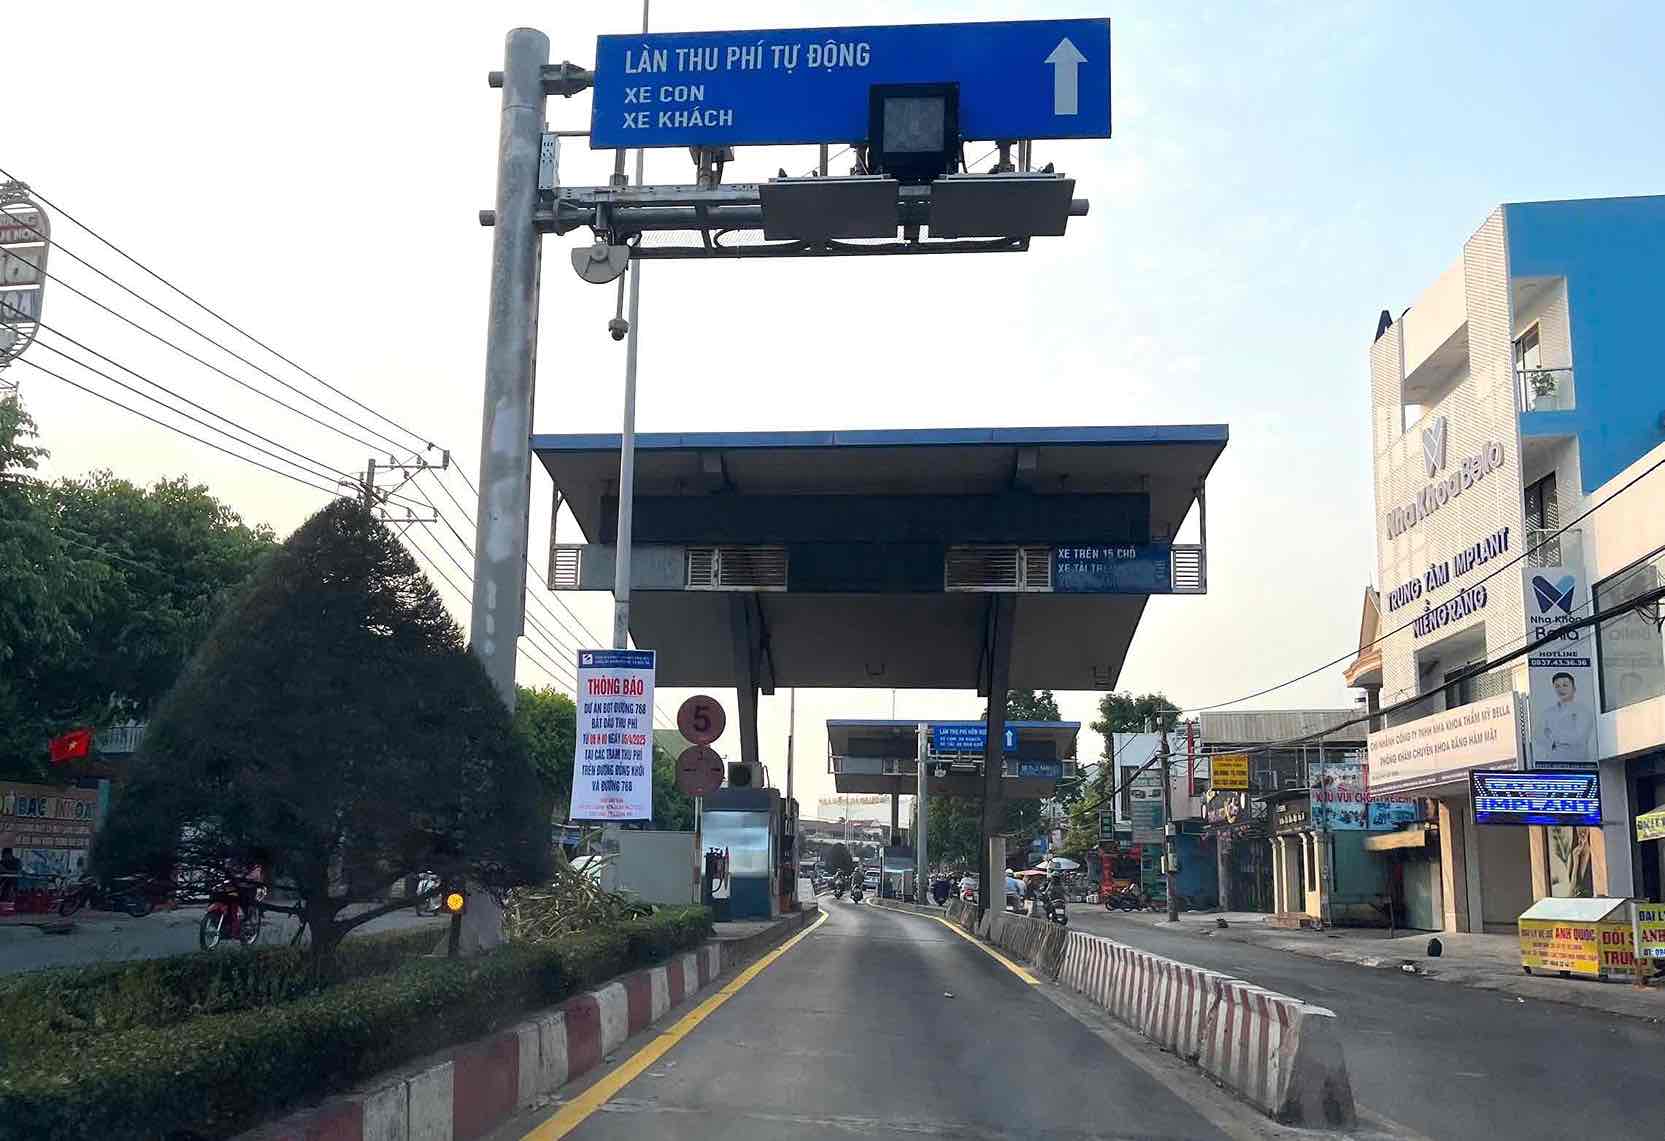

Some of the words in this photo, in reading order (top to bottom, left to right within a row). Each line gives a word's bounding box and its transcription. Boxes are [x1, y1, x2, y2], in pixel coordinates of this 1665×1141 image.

[625, 44, 668, 74] LÀN
[676, 48, 718, 72] THU
[726, 40, 763, 70] PHÍ
[772, 44, 800, 73] TỰ
[807, 40, 871, 72] ĐỘNG
[624, 86, 652, 104] XE
[660, 84, 705, 103] CON
[623, 111, 650, 129] XE
[658, 106, 733, 128] KHÁCH
[1058, 549, 1071, 559] XE
[1058, 564, 1071, 574] XE
